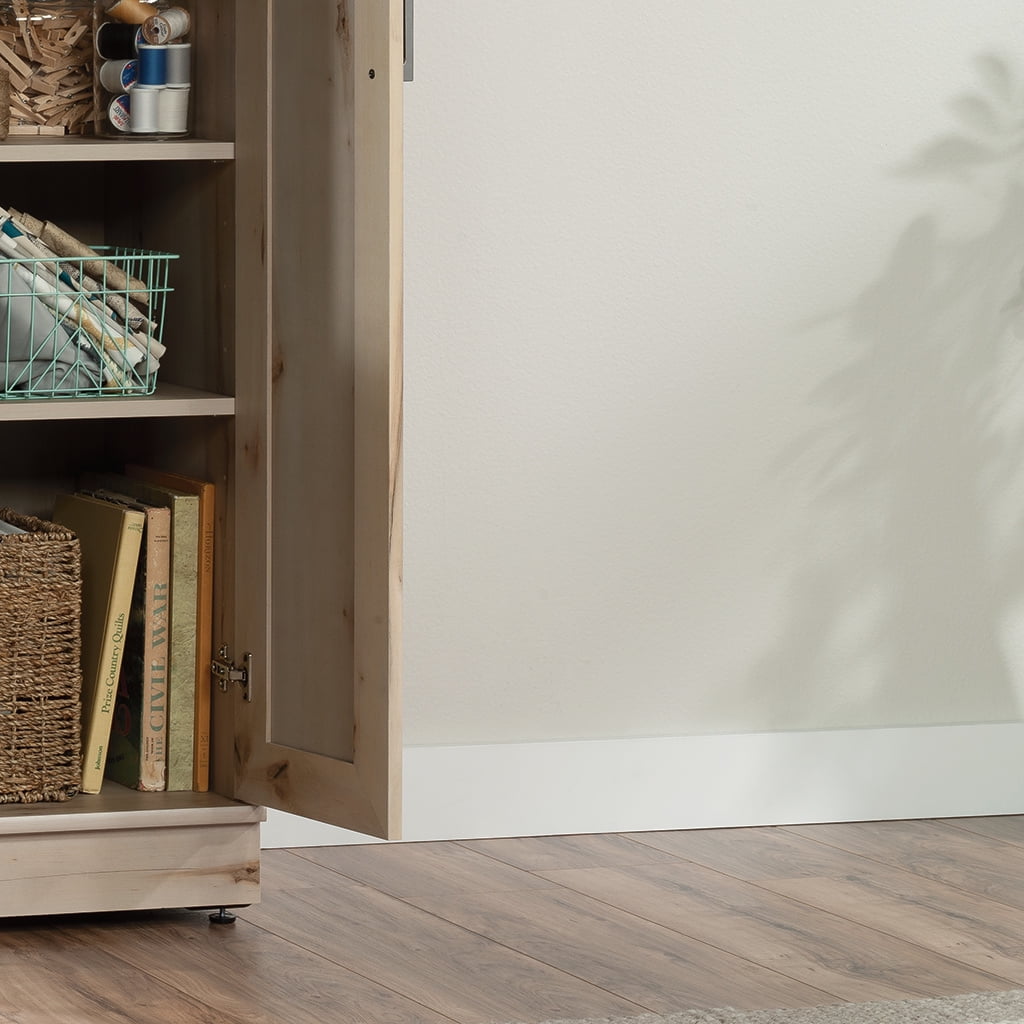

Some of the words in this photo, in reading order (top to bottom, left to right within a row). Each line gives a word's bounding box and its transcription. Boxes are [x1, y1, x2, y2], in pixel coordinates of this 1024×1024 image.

[112, 612, 125, 643] Quilts
[151, 583, 167, 649] WAR
[105, 643, 120, 687] Country
[101, 688, 113, 714] Prize
[149, 656, 166, 732] CIVIL
[94, 745, 104, 771] Johnson
